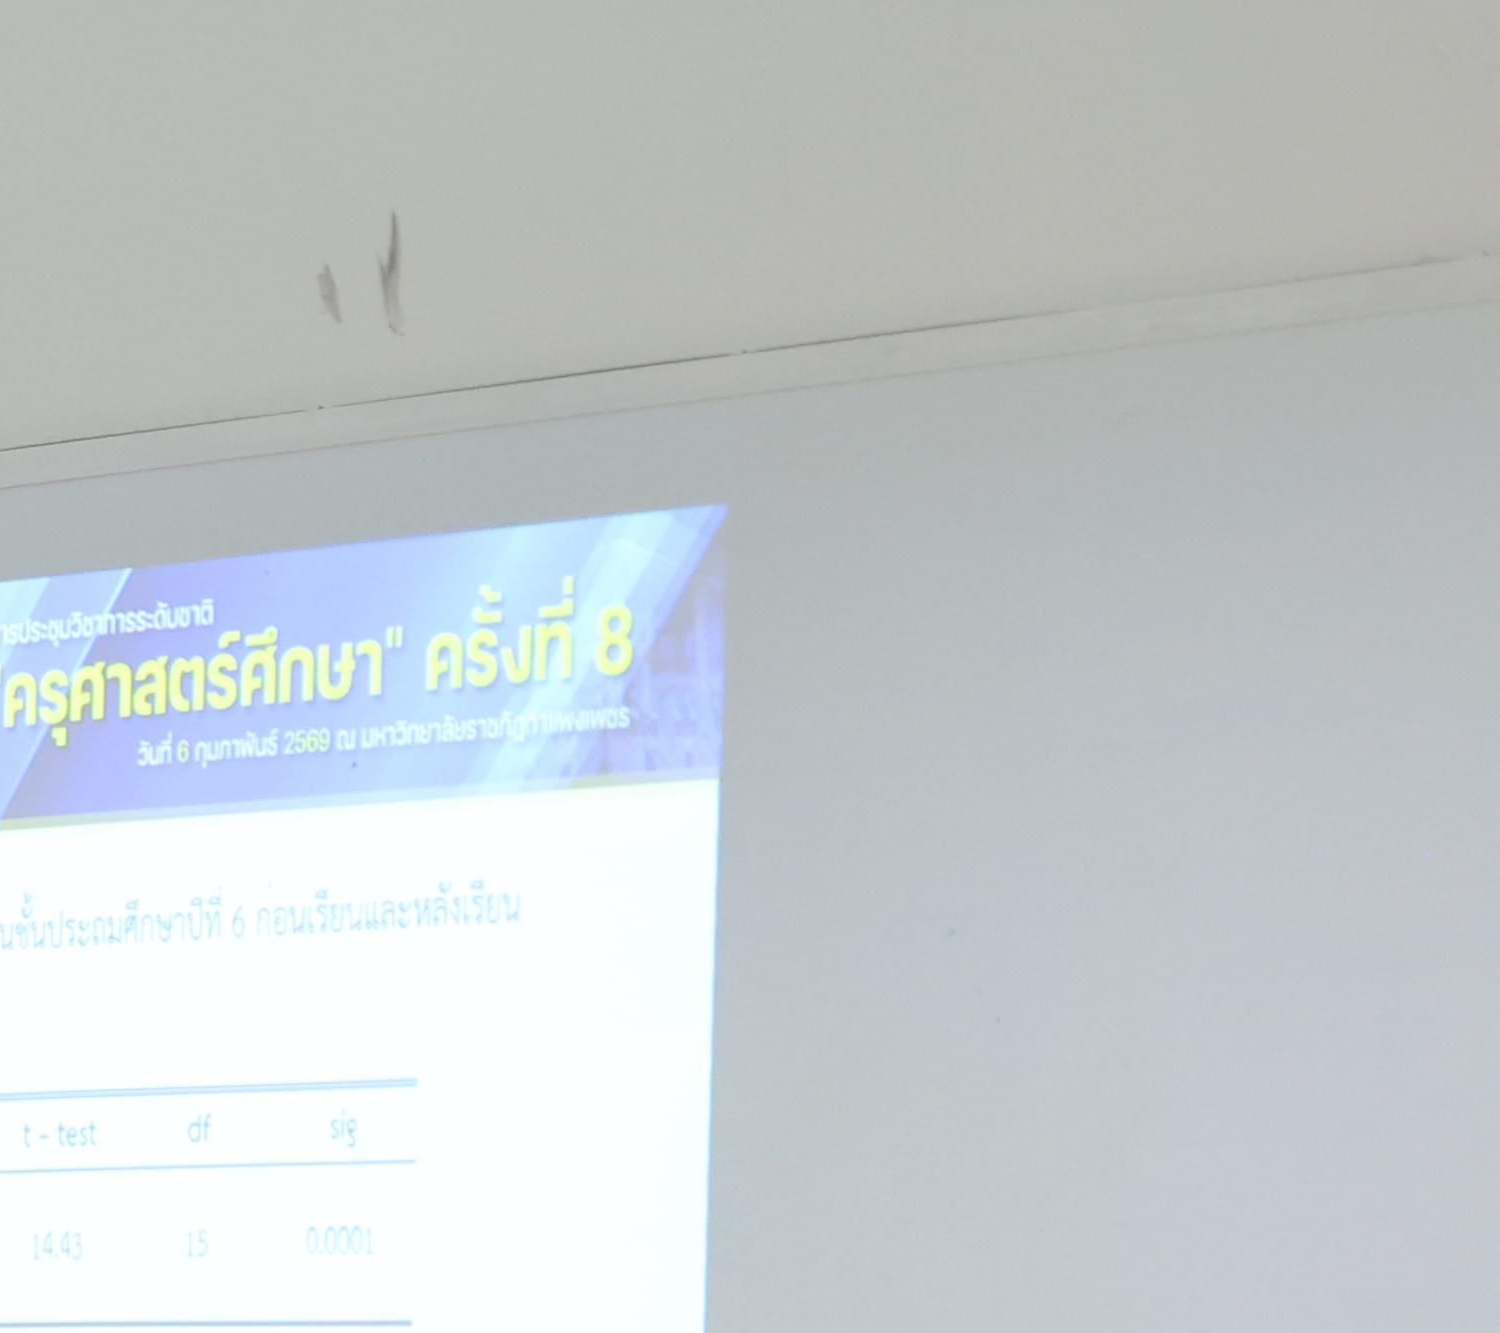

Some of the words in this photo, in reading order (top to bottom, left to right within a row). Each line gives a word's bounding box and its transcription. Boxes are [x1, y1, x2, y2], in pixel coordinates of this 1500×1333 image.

[425, 576, 573, 692] ครั้งที่
[595, 604, 634, 678] 8
[136, 726, 173, 766] วันที่
[178, 738, 190, 764] 6
[284, 726, 331, 757] 2569
[232, 907, 245, 939] 6
[57, 1119, 99, 1148] test
[186, 1112, 213, 1145] df
[330, 1107, 358, 1149] sig
[32, 1230, 84, 1262] 14.43
[186, 1228, 209, 1259] 15
[304, 1226, 374, 1257] 0.0001
